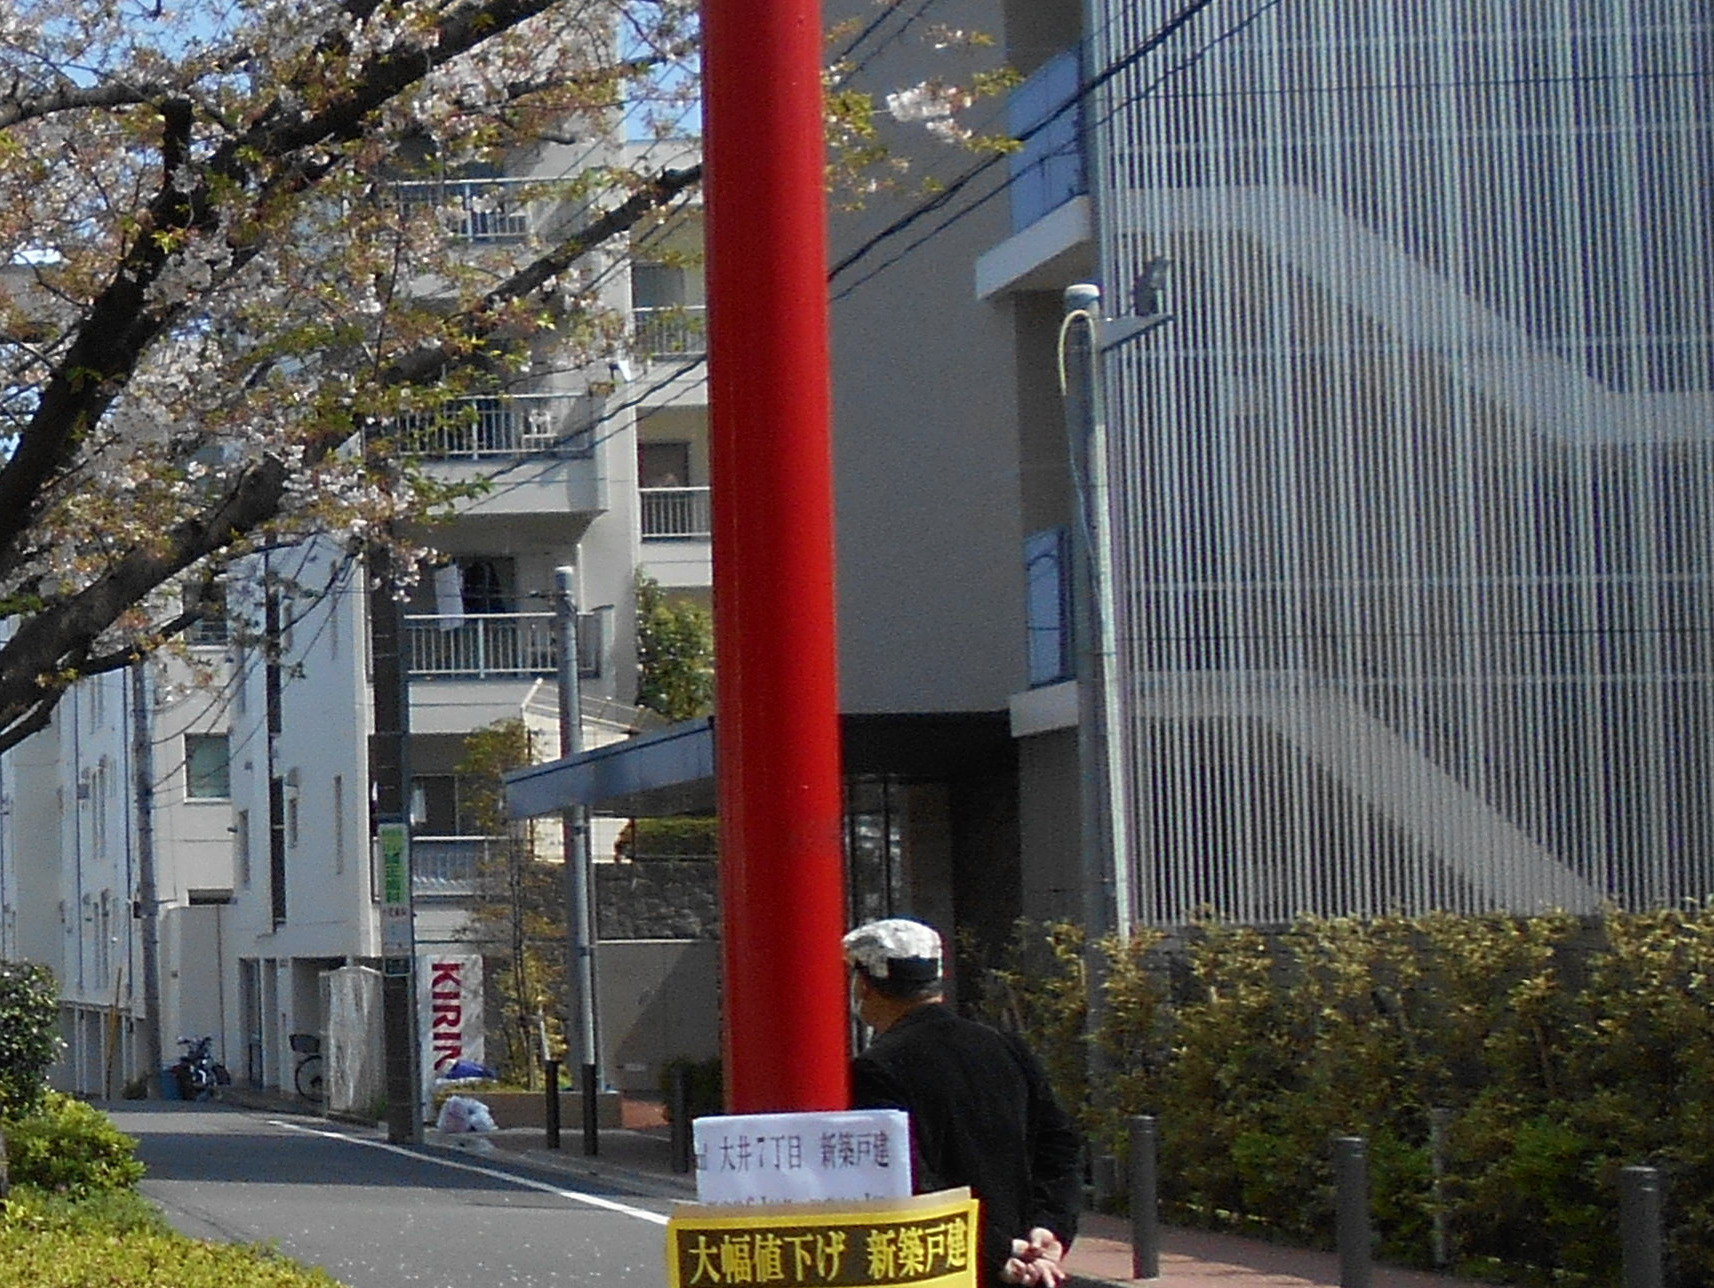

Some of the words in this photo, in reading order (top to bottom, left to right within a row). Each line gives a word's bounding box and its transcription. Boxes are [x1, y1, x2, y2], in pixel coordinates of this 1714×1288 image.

[432, 962, 462, 1071] KIRIN
[689, 1230, 847, 1285] 大幅値下げ
[866, 1217, 968, 1280] 新築戸建
